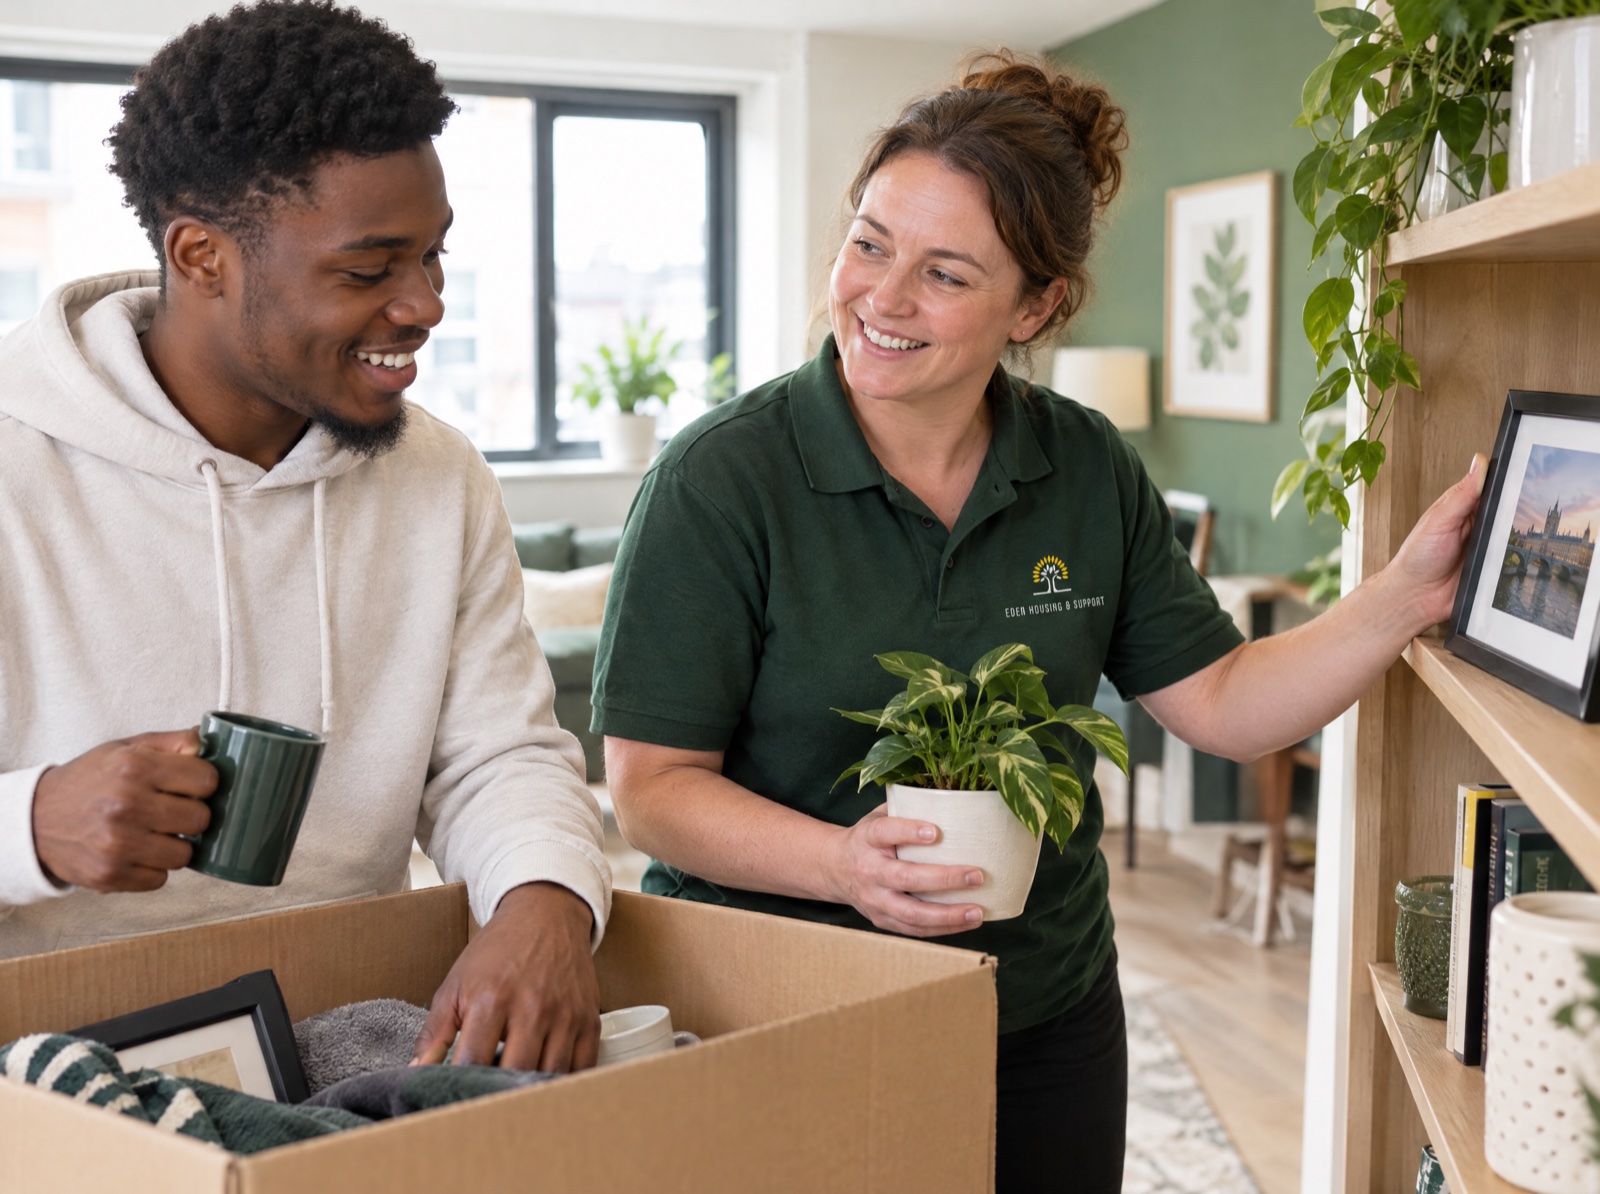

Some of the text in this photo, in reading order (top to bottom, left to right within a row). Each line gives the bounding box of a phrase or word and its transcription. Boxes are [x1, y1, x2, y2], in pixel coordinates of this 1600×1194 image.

[1005, 596, 1105, 618] EDEN HOUSING & SUPPORT
